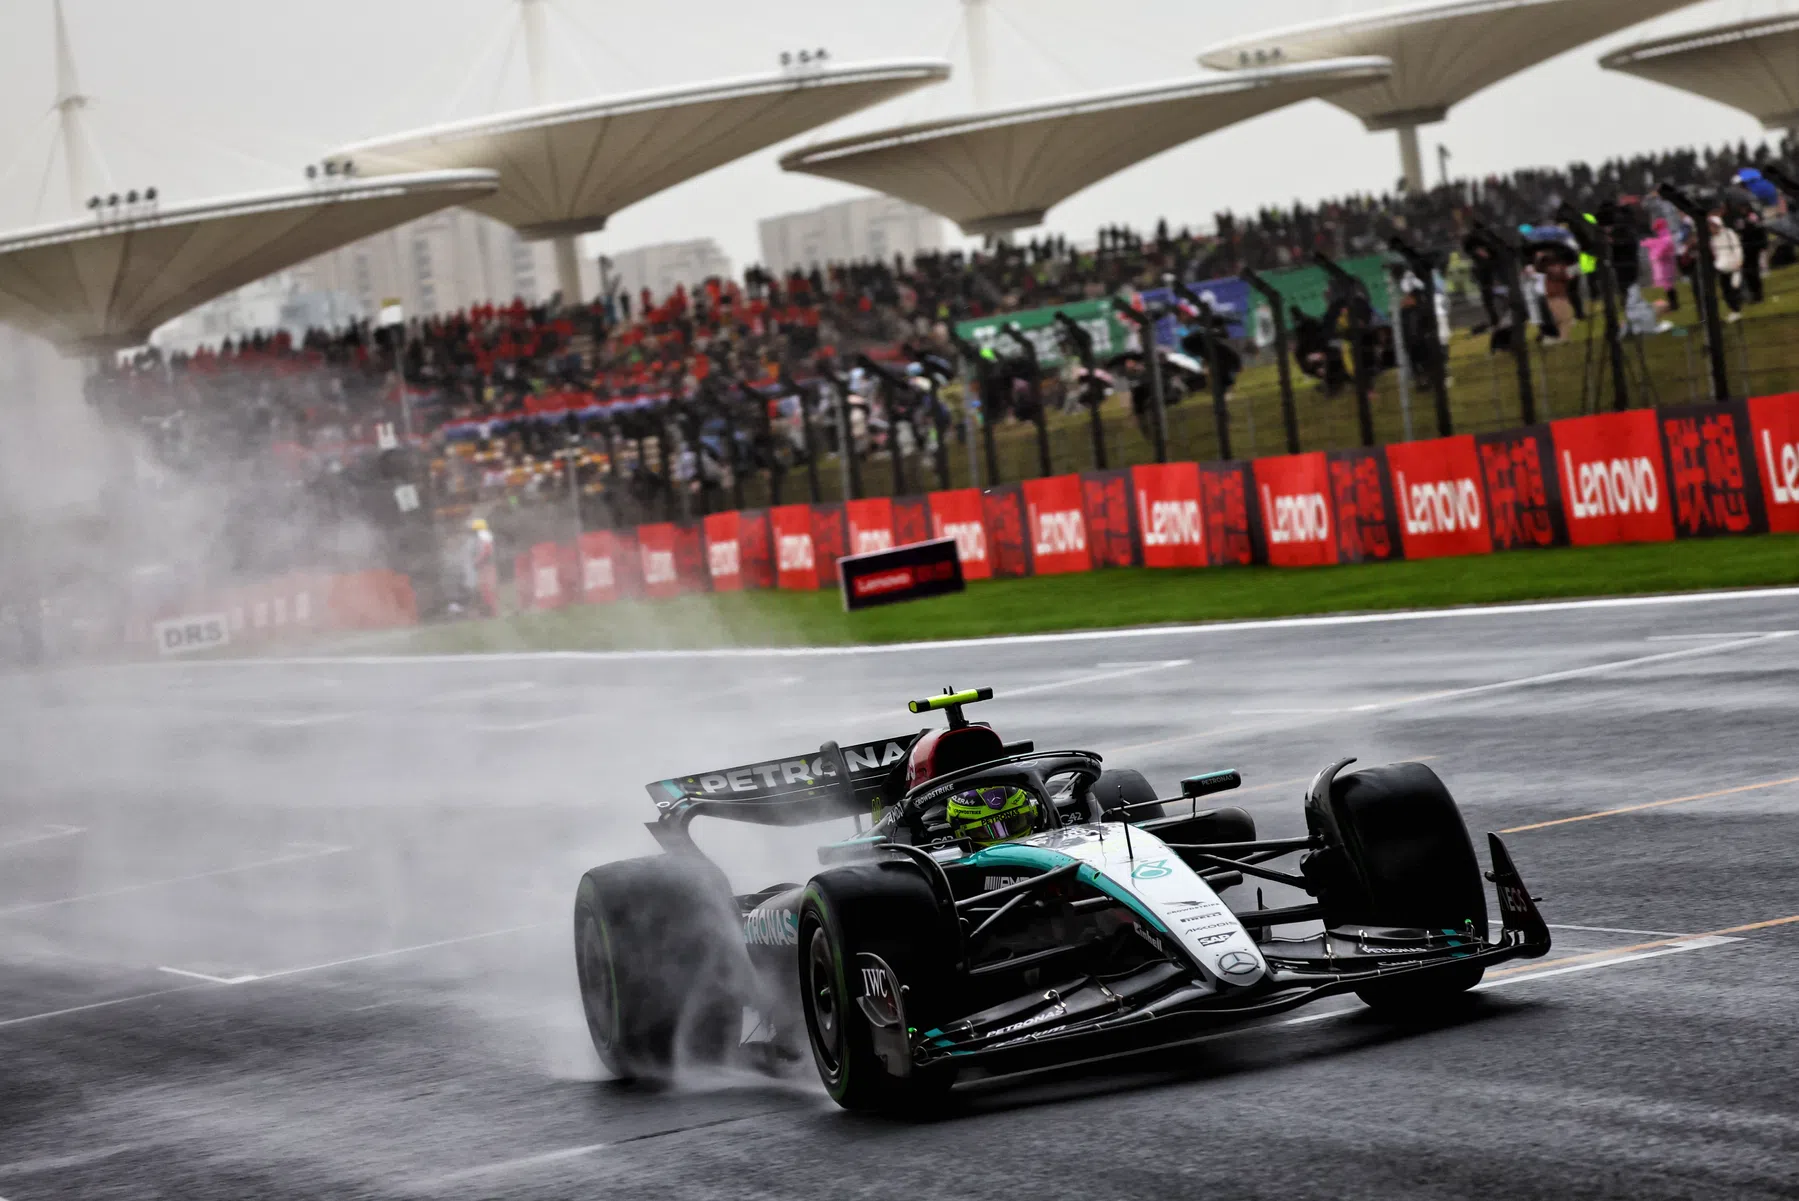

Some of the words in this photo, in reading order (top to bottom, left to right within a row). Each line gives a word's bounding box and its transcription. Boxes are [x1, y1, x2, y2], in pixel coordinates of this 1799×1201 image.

[1563, 449, 1658, 518] Lenovo
[1138, 489, 1201, 545] Lenovo
[1262, 483, 1328, 543] Lenovo
[1397, 470, 1480, 535] Lenovo
[164, 620, 222, 649] DRS
[700, 742, 905, 793] PETRONA
[1201, 774, 1234, 786] PETRONAS
[914, 783, 955, 809] CROWDSTRIKE
[982, 808, 1020, 827] PETRONAS
[1059, 811, 1084, 826] G42
[1166, 902, 1220, 915] CROWDSTRIKE
[1185, 921, 1238, 936] AKKODIS
[1199, 933, 1230, 945] SAP
[861, 968, 888, 998] IWC
[986, 1007, 1065, 1038] PETRONAS
